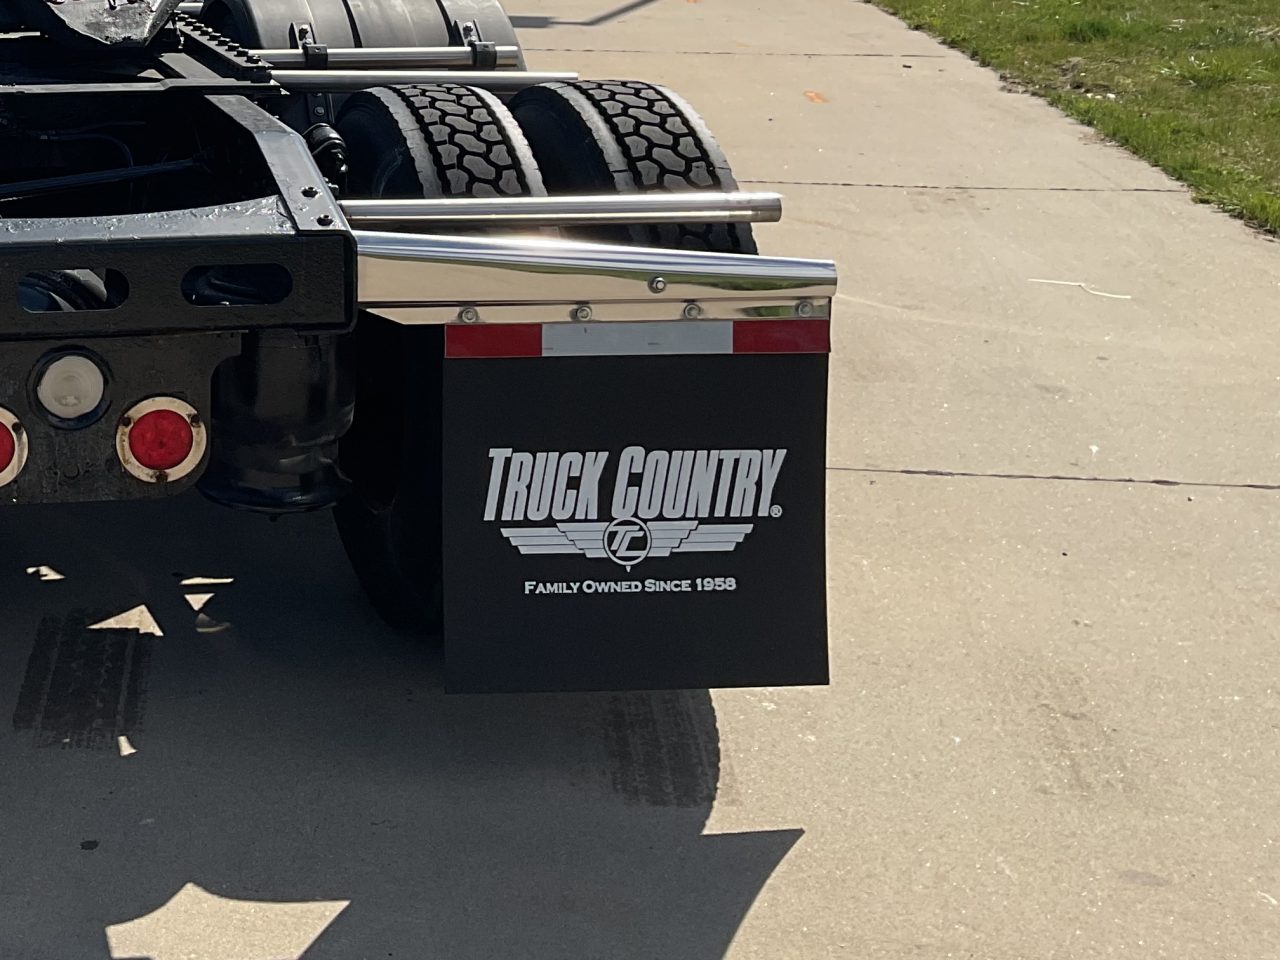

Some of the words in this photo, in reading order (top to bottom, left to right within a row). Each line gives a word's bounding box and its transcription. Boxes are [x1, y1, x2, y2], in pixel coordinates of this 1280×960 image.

[483, 447, 609, 521] TRUCK
[611, 445, 787, 519] COUNTRY
[524, 580, 580, 594] FAMILY
[582, 580, 642, 593] OWNED
[644, 578, 691, 592] SINCE
[695, 577, 737, 591] 1958
